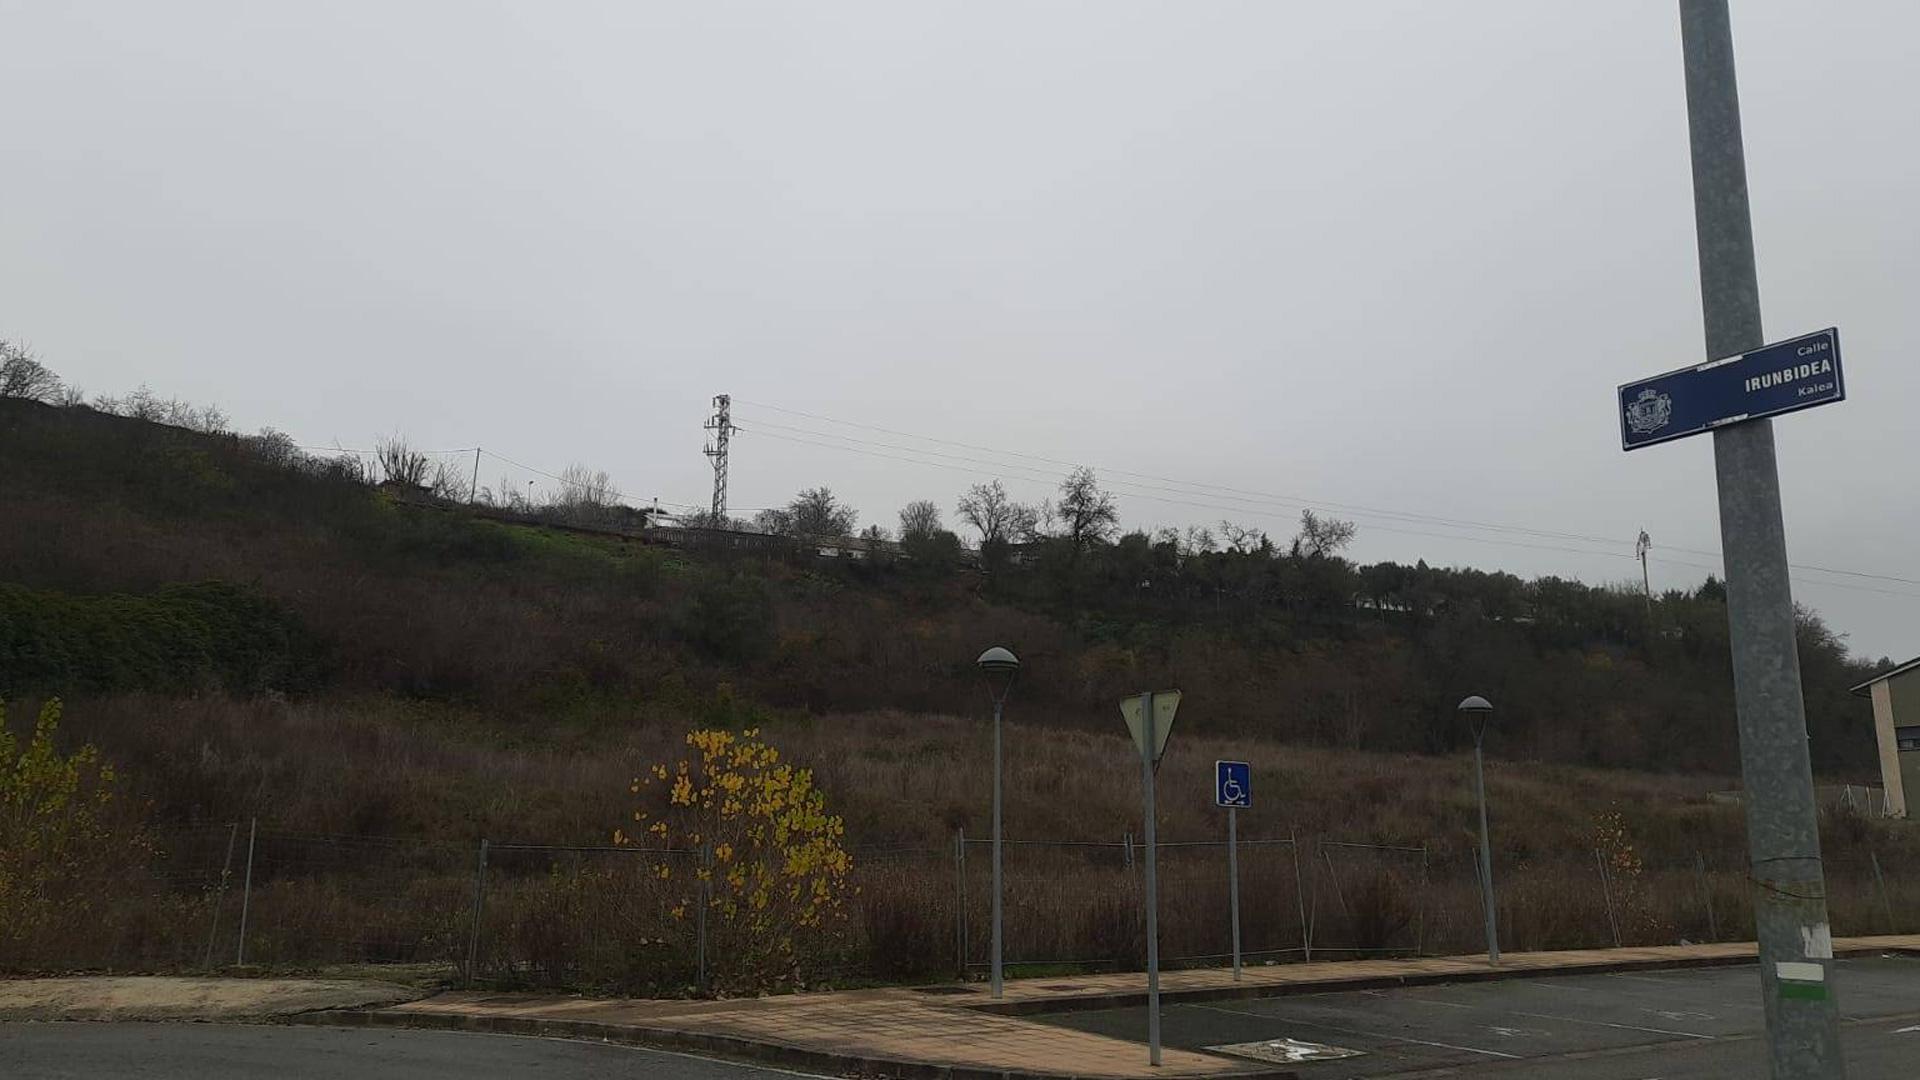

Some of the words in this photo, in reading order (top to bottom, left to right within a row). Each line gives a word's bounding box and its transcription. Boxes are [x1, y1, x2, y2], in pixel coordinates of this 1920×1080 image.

[1797, 342, 1828, 356] Calle
[1745, 359, 1831, 392] IRUNBIDEA
[1798, 382, 1833, 396] Kalea
